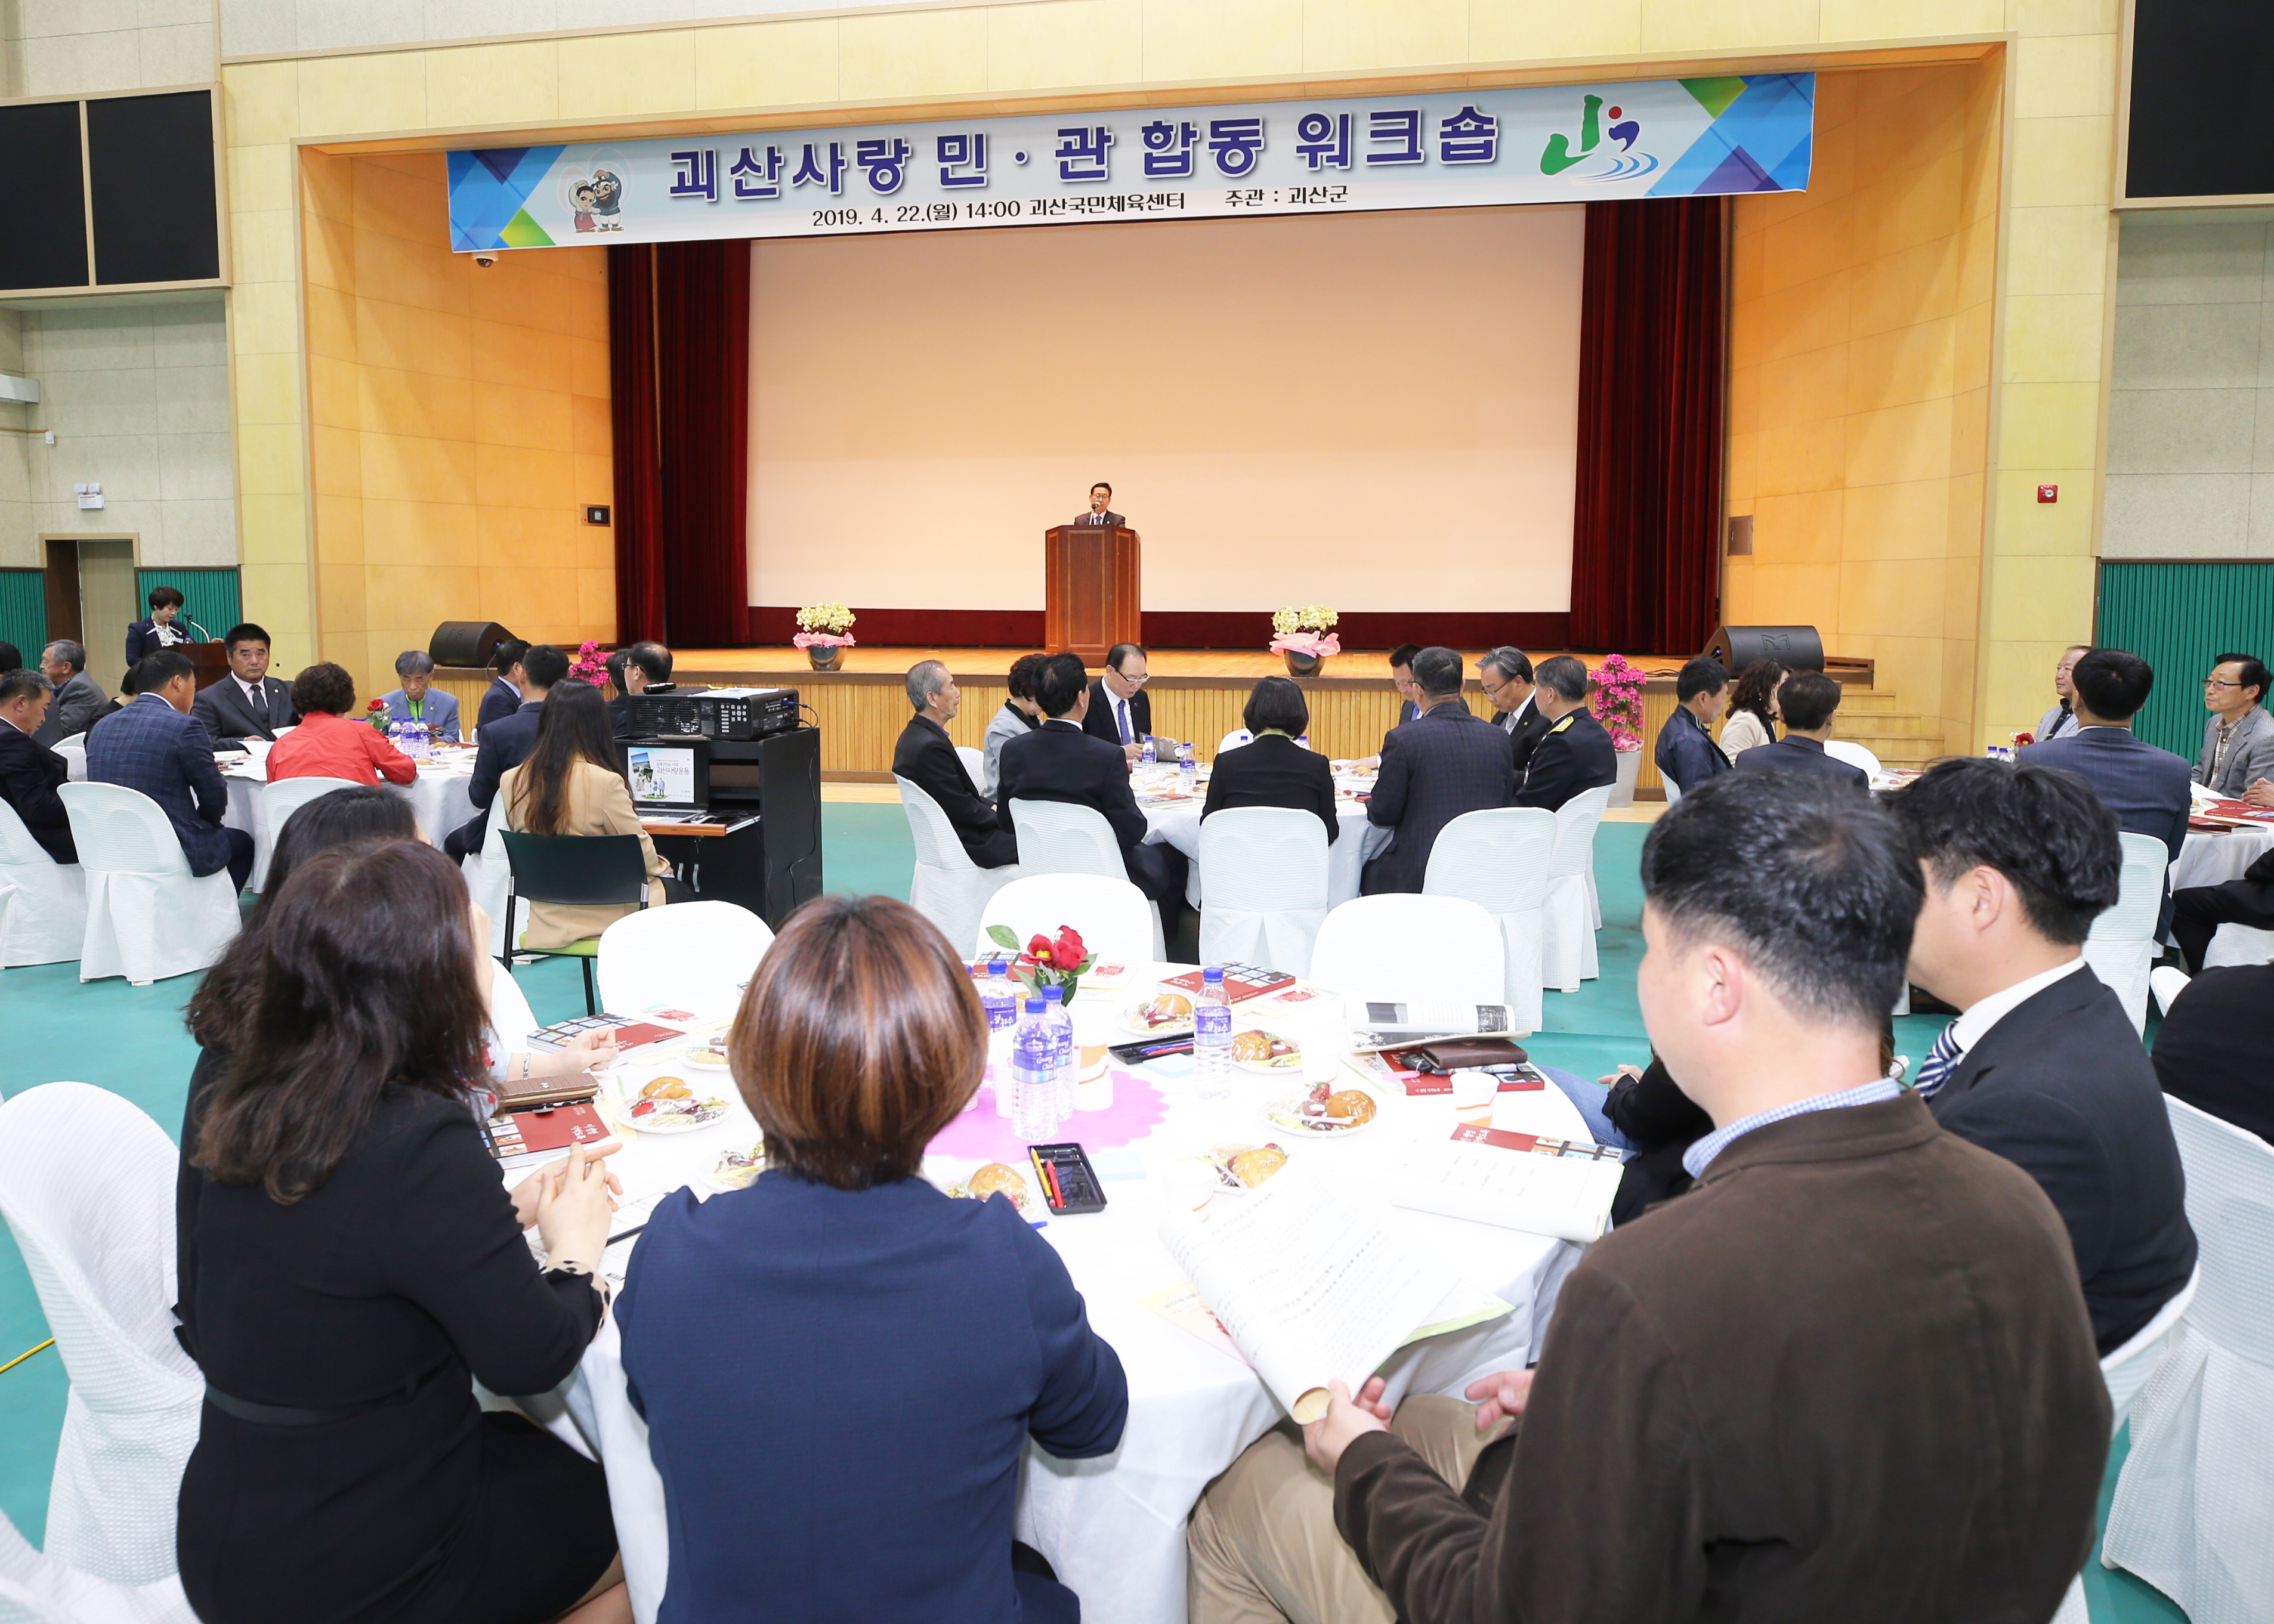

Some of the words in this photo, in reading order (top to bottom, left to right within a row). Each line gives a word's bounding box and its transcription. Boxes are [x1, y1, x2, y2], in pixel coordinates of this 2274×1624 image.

[669, 137, 910, 201] 괴산사랑
[937, 132, 986, 187] 민
[1054, 126, 1113, 181] 관
[1141, 118, 1263, 177] 합동
[1295, 106, 1497, 169] 워크숍
[812, 209, 863, 226] 2019.
[871, 208, 888, 224] 4.
[897, 202, 958, 222] 22.(월)
[966, 200, 1021, 218] 14:00
[1030, 193, 1185, 216] 괴산국민체육센터
[1225, 189, 1265, 207] 주관
[1287, 185, 1348, 204] 괴산군
